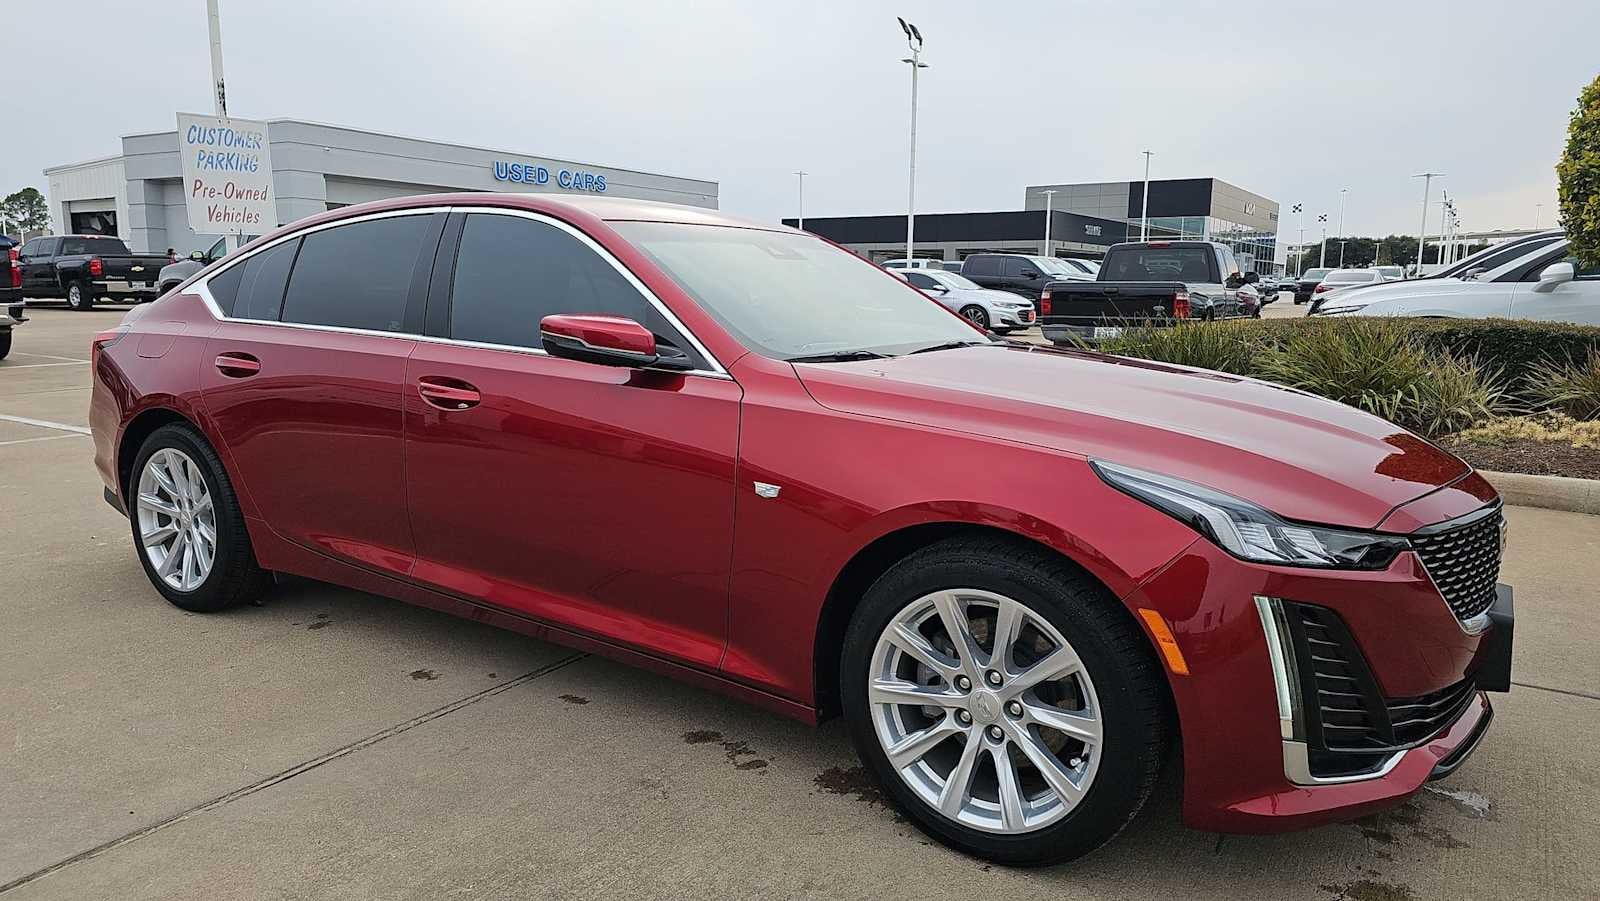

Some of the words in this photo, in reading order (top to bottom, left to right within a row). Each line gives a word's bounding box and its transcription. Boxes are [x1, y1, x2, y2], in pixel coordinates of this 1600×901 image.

[187, 124, 262, 149] CUSTOMER
[196, 149, 258, 173] PARKING
[494, 160, 550, 185] USED
[557, 169, 608, 192] CARS
[192, 179, 269, 201] Pre-Owned
[207, 203, 260, 224] Vehicles
